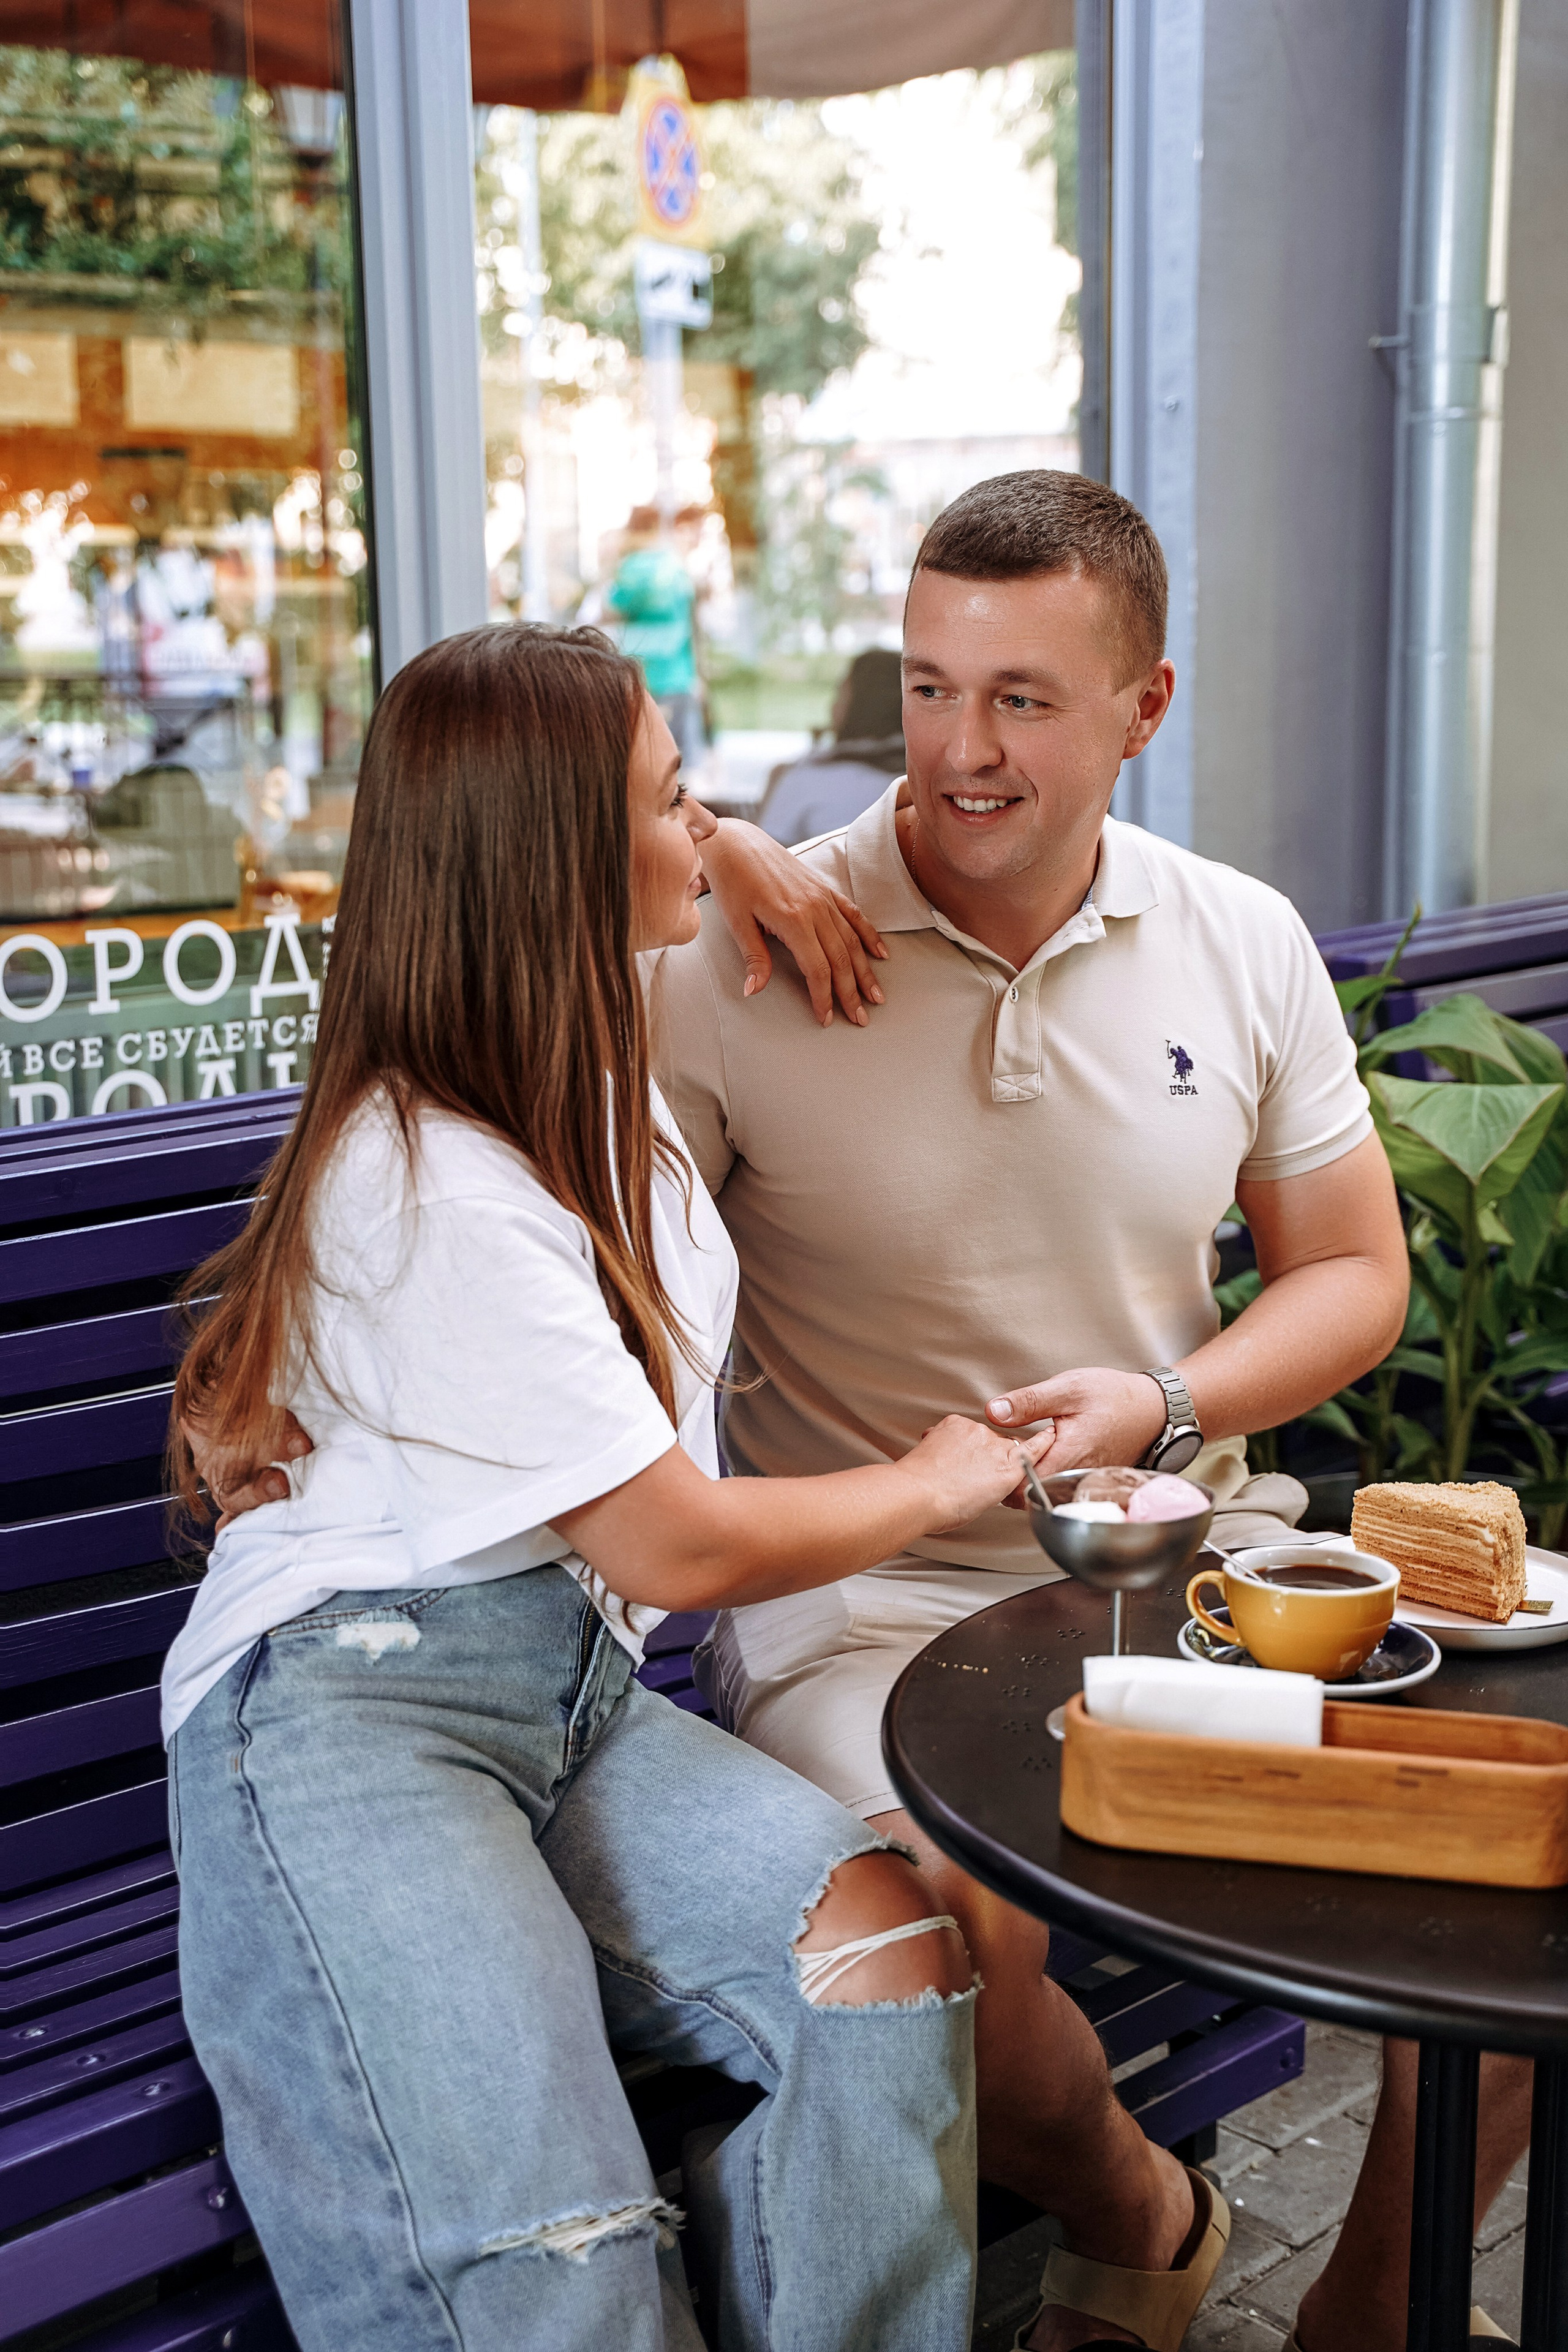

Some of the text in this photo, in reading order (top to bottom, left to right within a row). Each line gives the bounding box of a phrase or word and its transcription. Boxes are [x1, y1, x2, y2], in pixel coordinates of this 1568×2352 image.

[22, 1036, 104, 1076] ВСЕ
[116, 1012, 319, 1065] СБУДЕТСЯ
[1169, 1085, 1199, 1095] USPA
